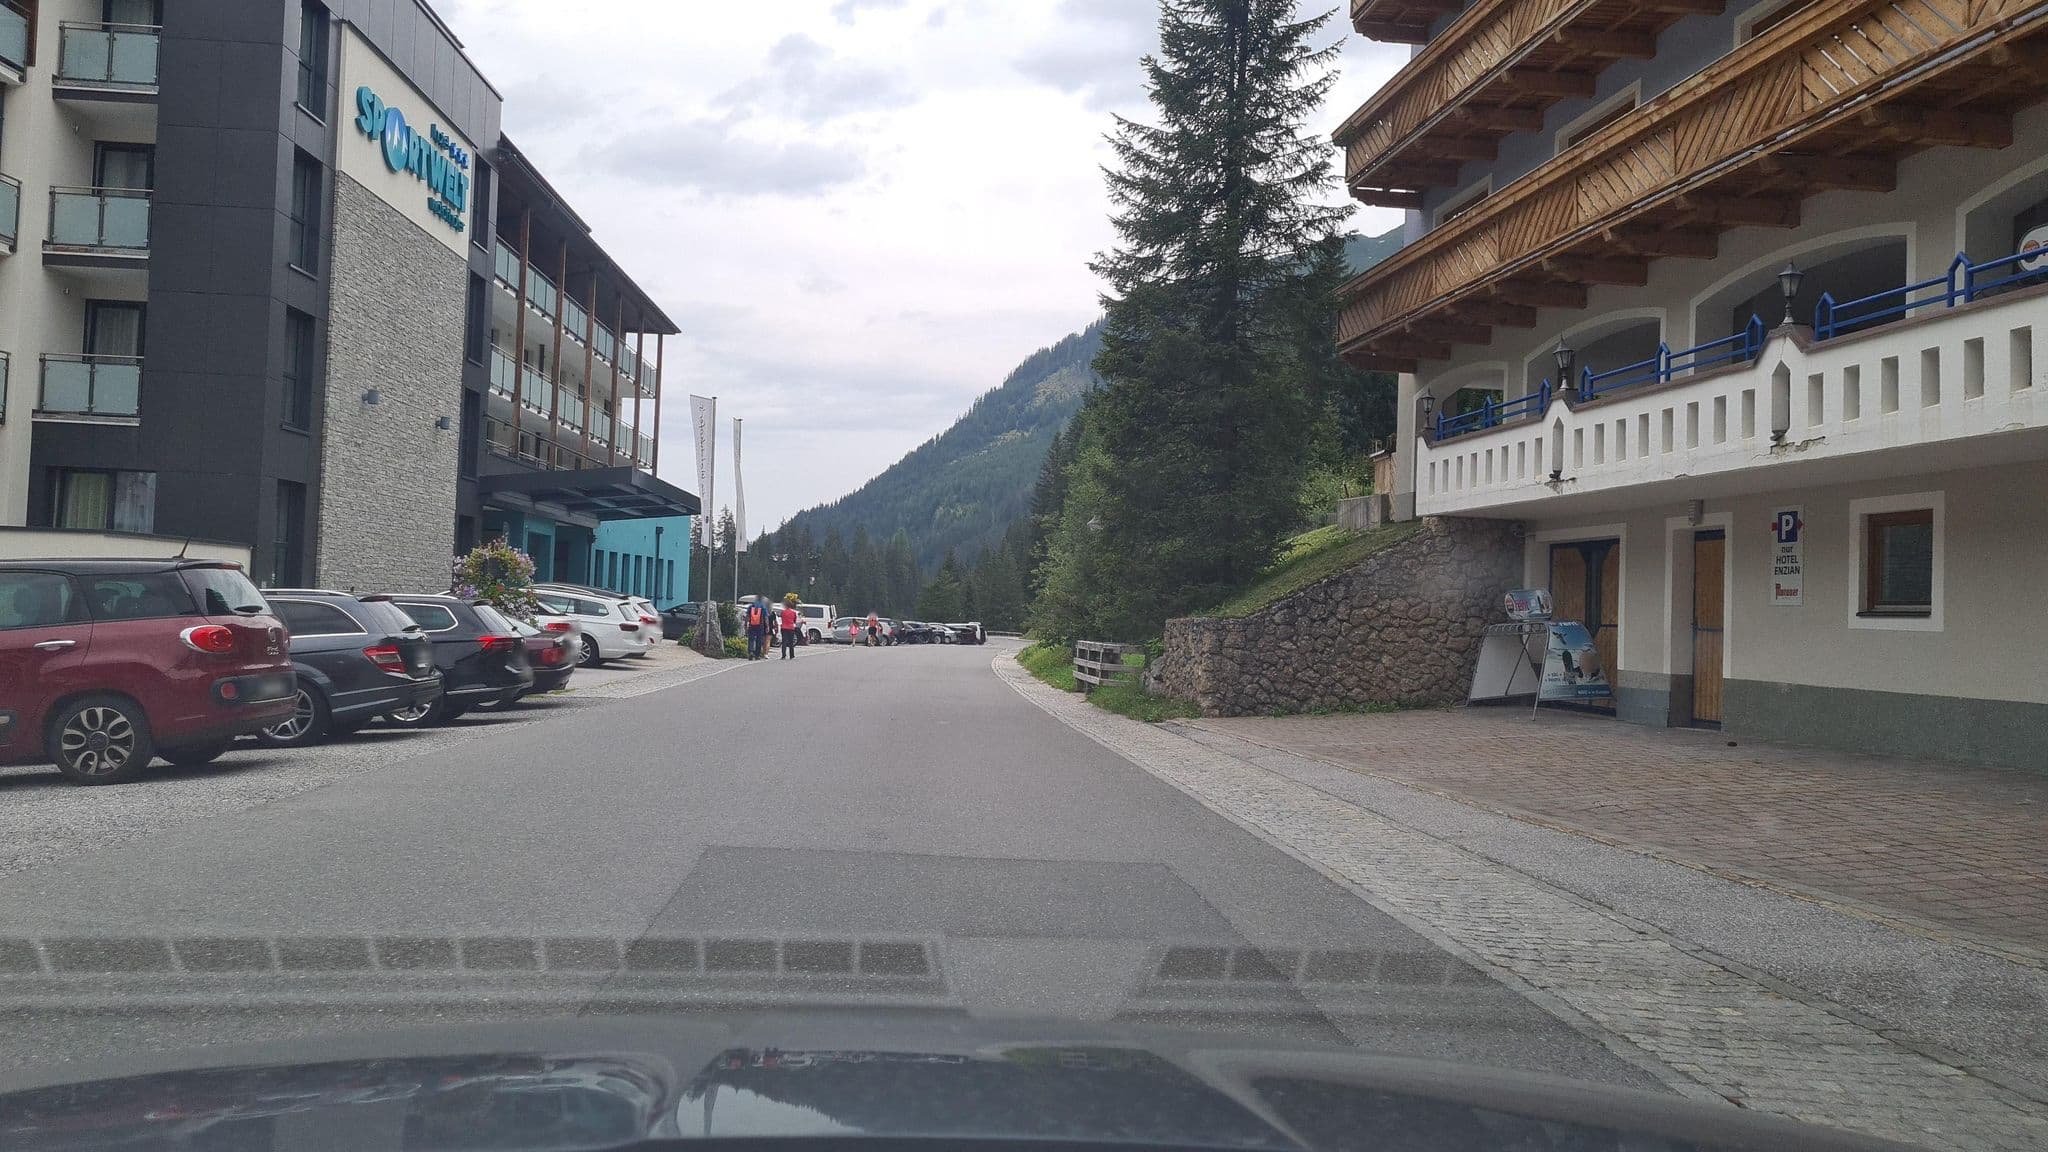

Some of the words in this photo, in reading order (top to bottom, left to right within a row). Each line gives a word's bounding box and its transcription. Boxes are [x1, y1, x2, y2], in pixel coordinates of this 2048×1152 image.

[355, 86, 469, 213] SPORTWELT
[1781, 514, 1794, 540] P
[1776, 555, 1799, 565] HOTEL
[1774, 566, 1800, 575] ENZIAN
